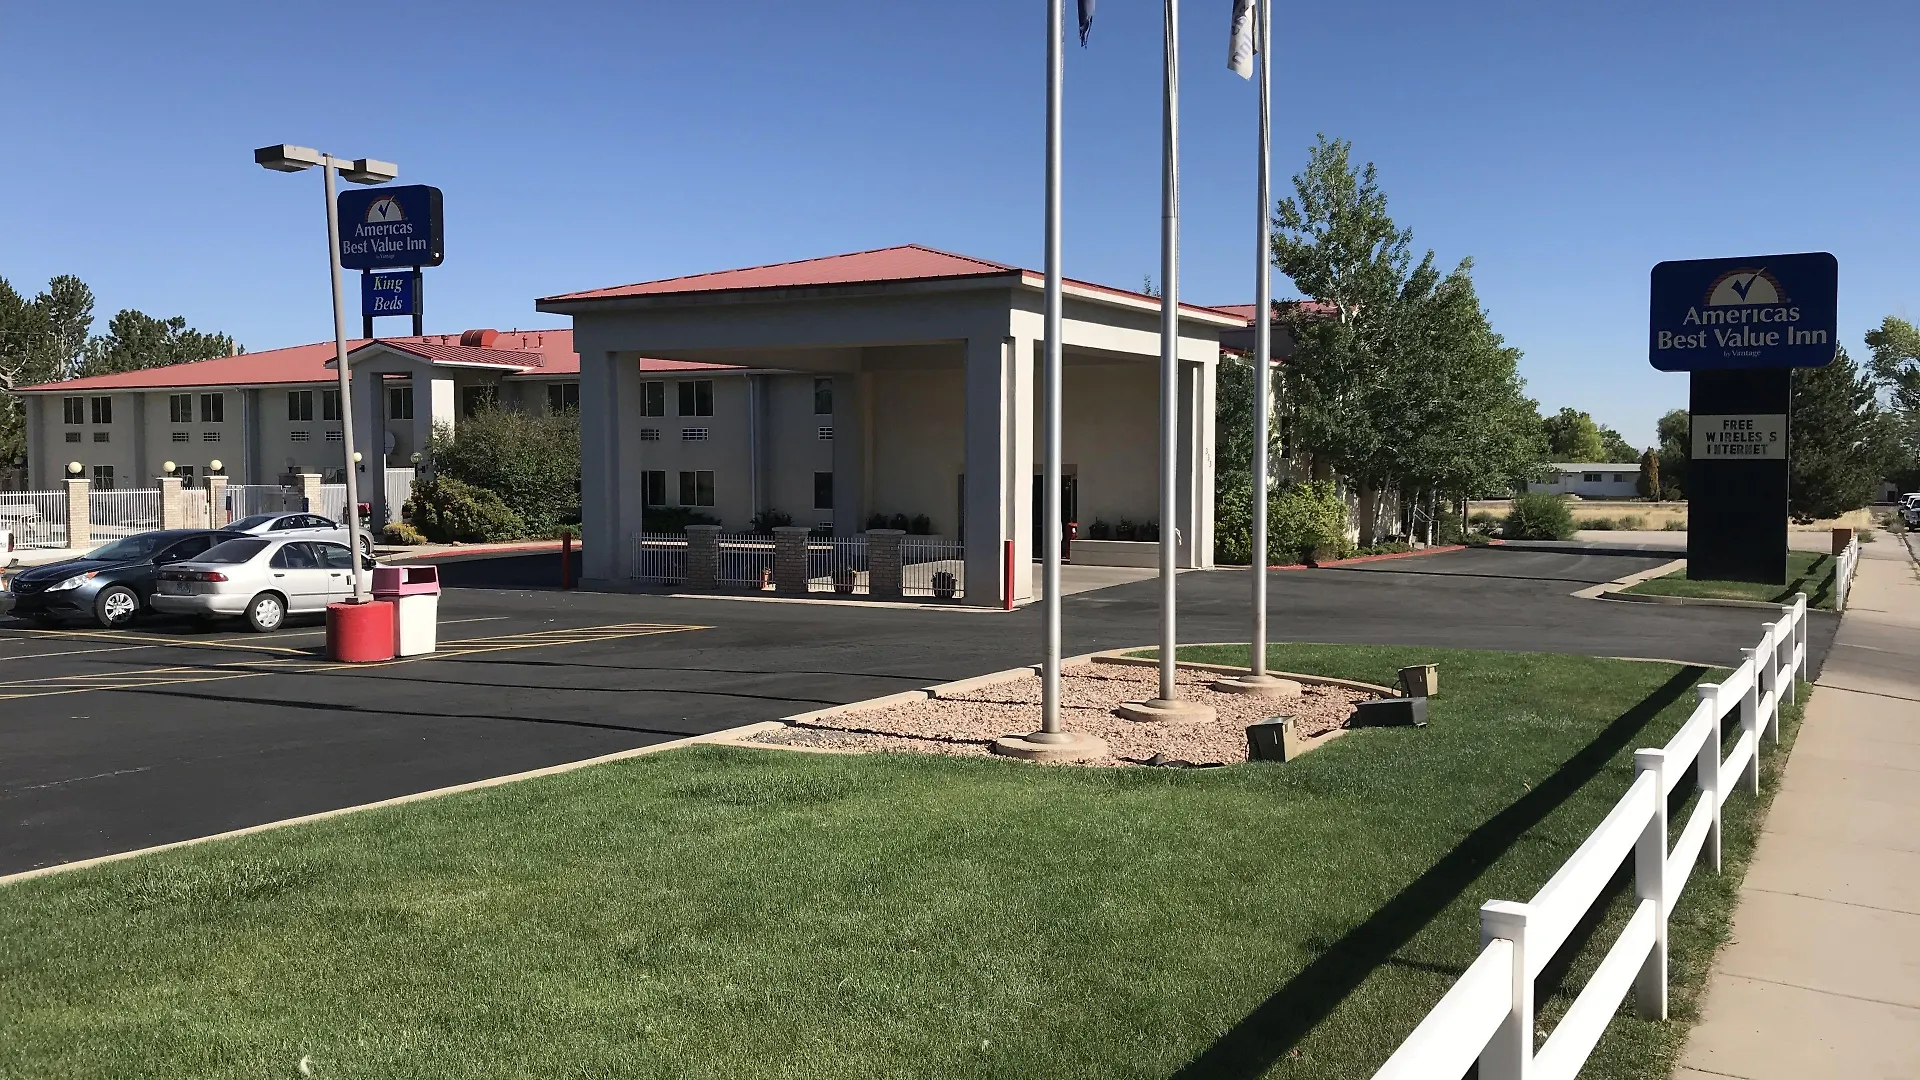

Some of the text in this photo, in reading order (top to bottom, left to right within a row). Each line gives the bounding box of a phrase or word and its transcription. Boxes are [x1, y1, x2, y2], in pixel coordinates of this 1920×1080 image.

[355, 223, 413, 237] Americas
[343, 237, 426, 254] Best Value Inn
[374, 276, 403, 293] King
[374, 296, 403, 311] Beds
[1682, 306, 1800, 326] Americas
[1658, 325, 1827, 350] Best Value Inn
[1731, 349, 1761, 357] Vantage
[1723, 419, 1753, 430] FREE
[1707, 444, 1768, 455] INTERNET
